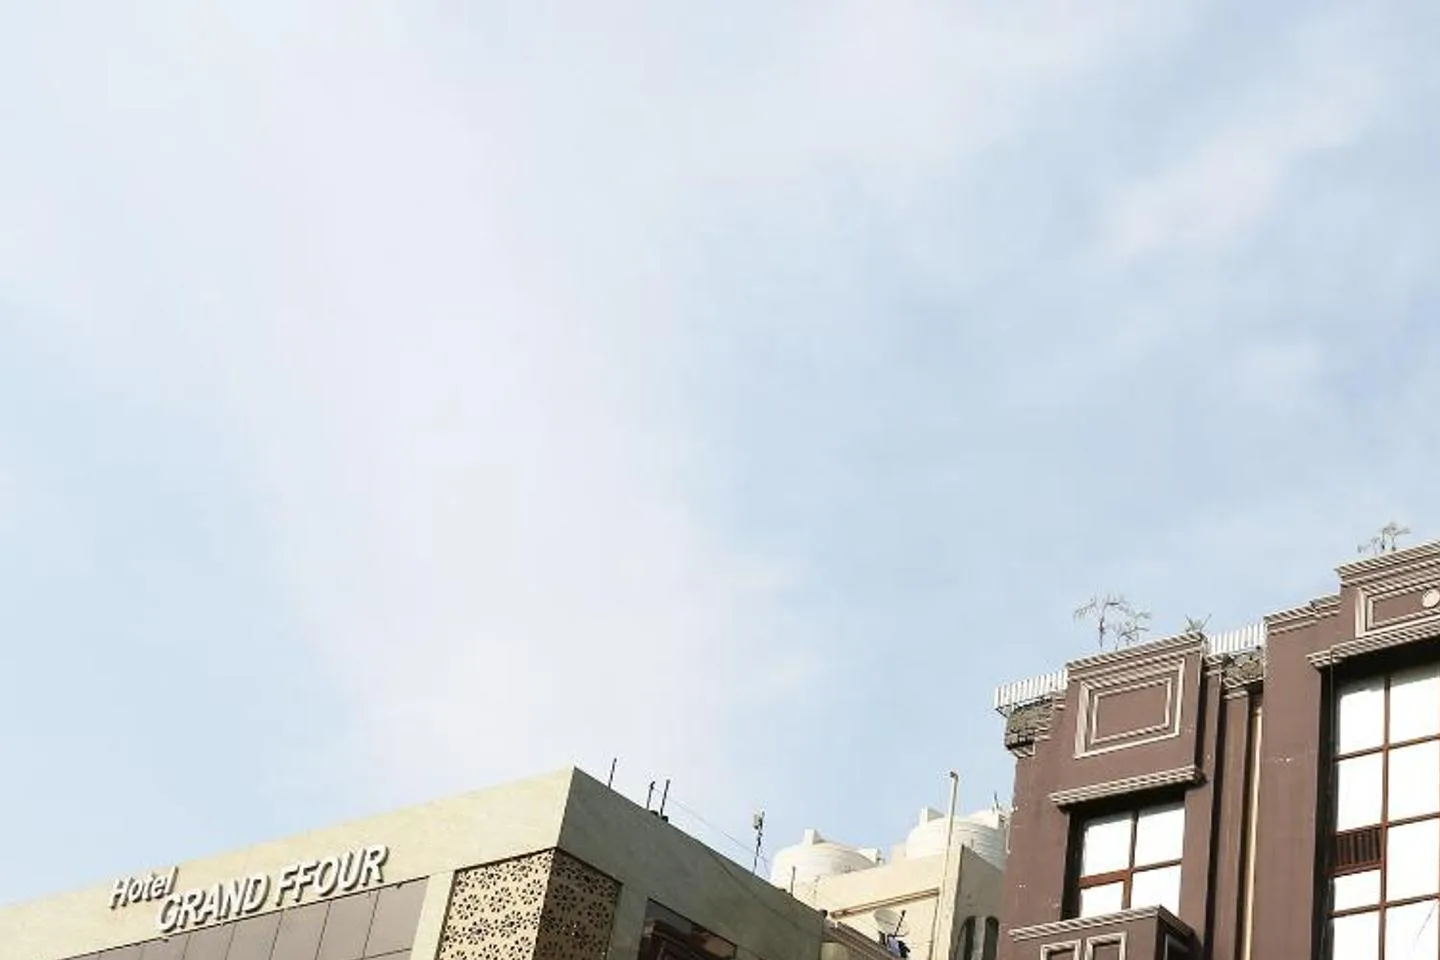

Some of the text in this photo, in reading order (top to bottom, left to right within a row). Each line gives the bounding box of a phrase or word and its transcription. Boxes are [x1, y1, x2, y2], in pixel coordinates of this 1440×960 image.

[109, 866, 178, 910] Hotel
[156, 844, 390, 934] GRAND FFOUR
